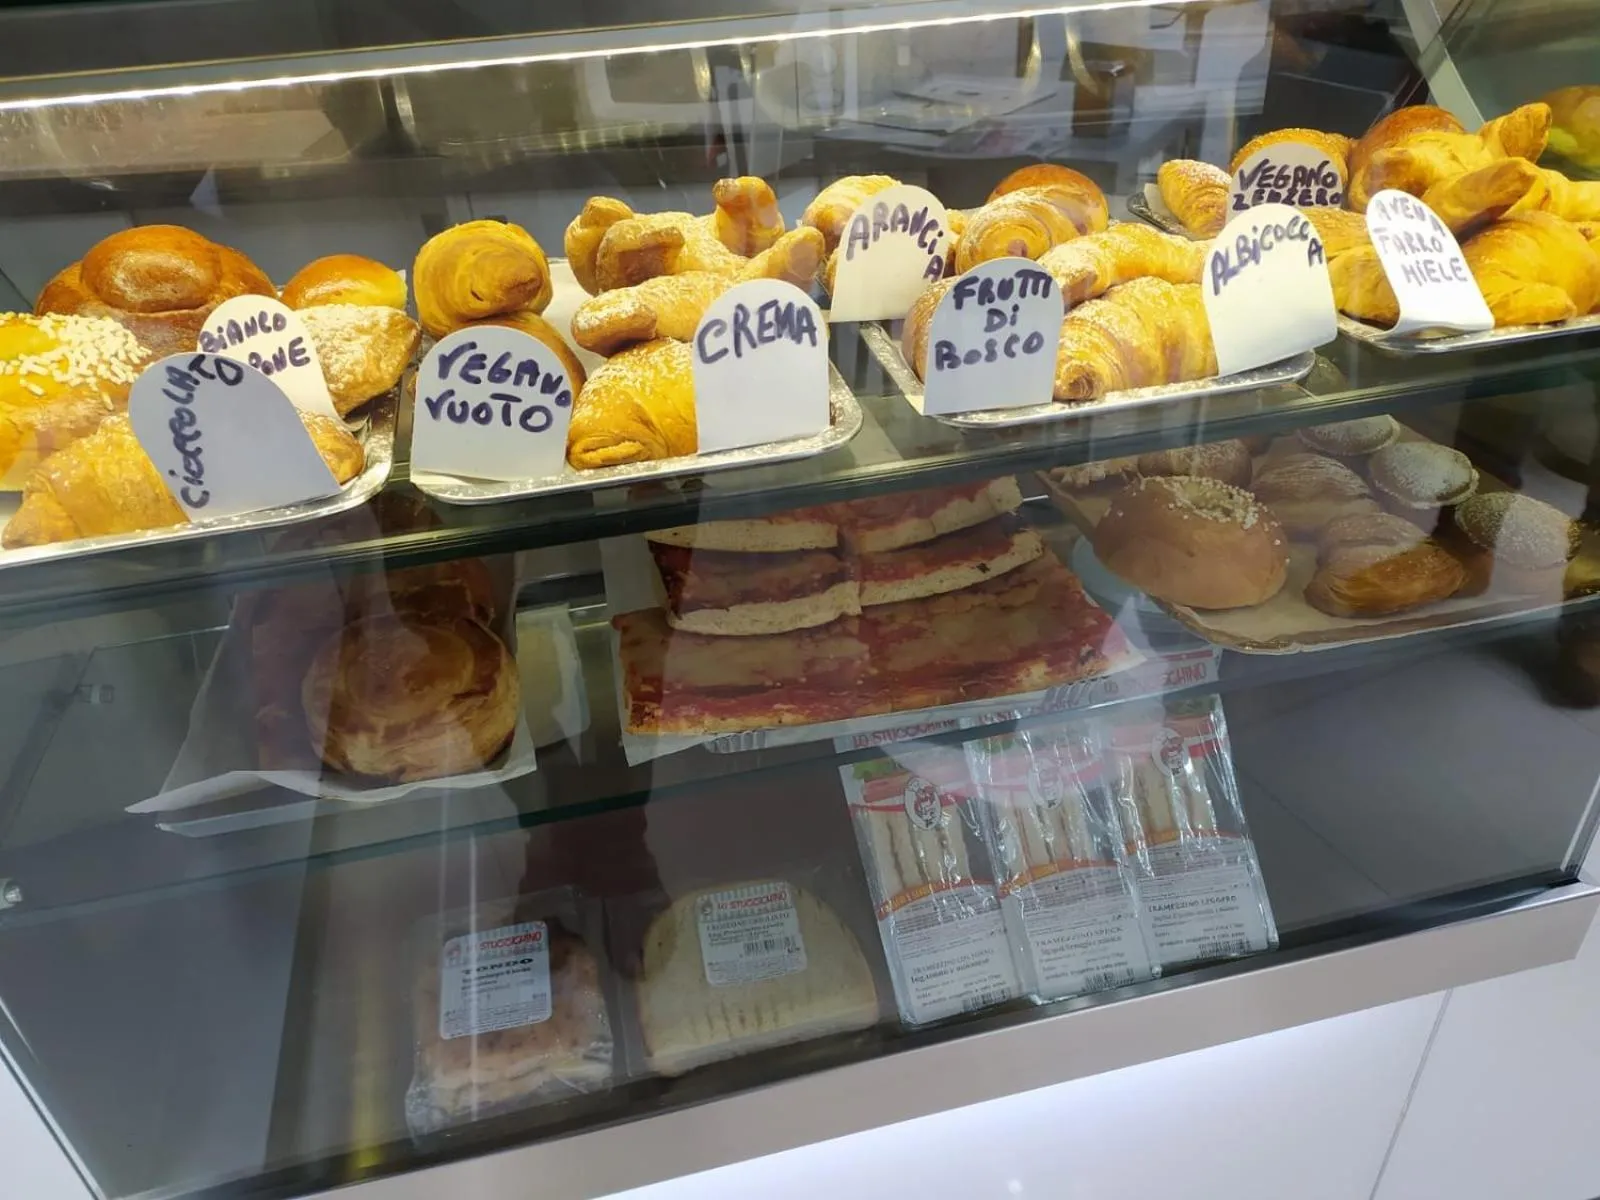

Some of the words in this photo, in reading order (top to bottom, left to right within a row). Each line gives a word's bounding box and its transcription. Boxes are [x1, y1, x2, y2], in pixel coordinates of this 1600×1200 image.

[1238, 158, 1339, 192] VEGANO
[1401, 256, 1468, 287] MIELE
[697, 299, 818, 365] CREMA
[935, 331, 1045, 371] BOSCO
[438, 341, 572, 408] VEGANO
[425, 389, 553, 433] VUOTO
